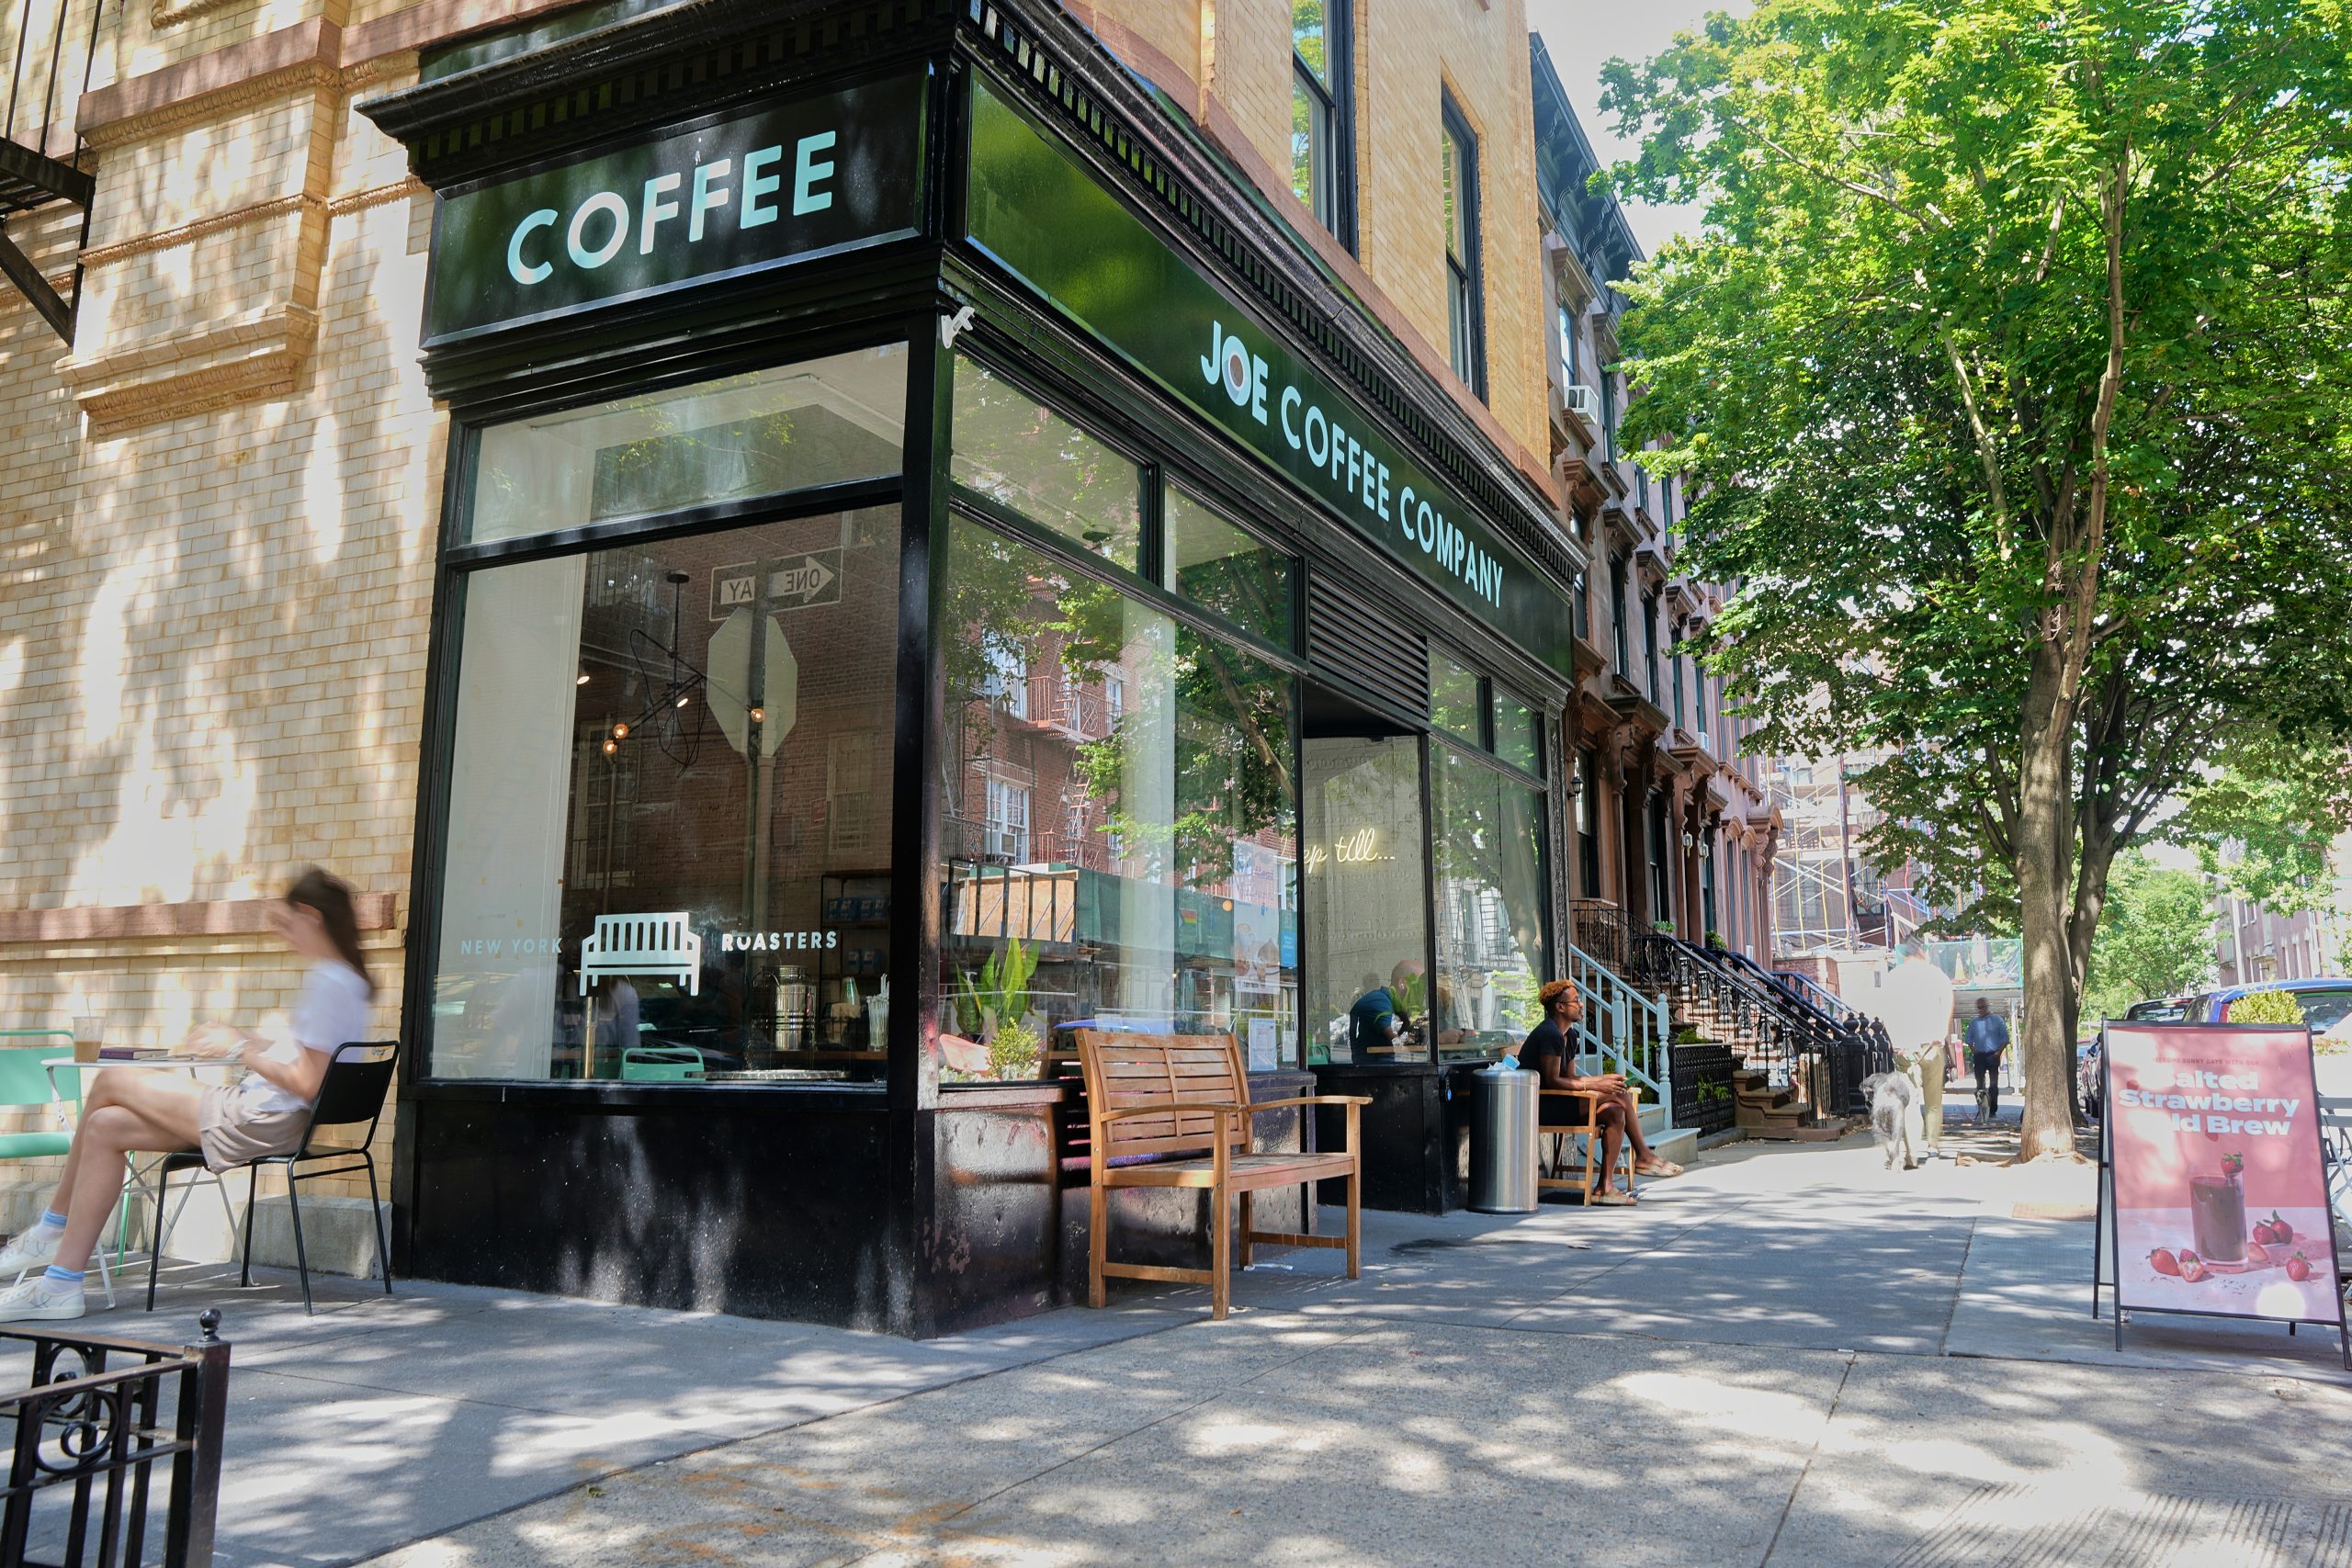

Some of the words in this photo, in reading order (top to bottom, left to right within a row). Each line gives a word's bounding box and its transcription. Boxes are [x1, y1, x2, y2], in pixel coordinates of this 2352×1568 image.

[507, 130, 836, 285] COFFEE
[1201, 320, 1269, 426] JOE
[1281, 386, 1390, 522] COFFEE
[1399, 486, 1504, 608] COMPANY
[1304, 844, 1329, 874] ep
[460, 940, 503, 955] NEW
[511, 937, 563, 954] YORK
[721, 931, 838, 952] ROASTERS
[2118, 1088, 2301, 1119] Strawberry
[2206, 1115, 2291, 1136] Brew
